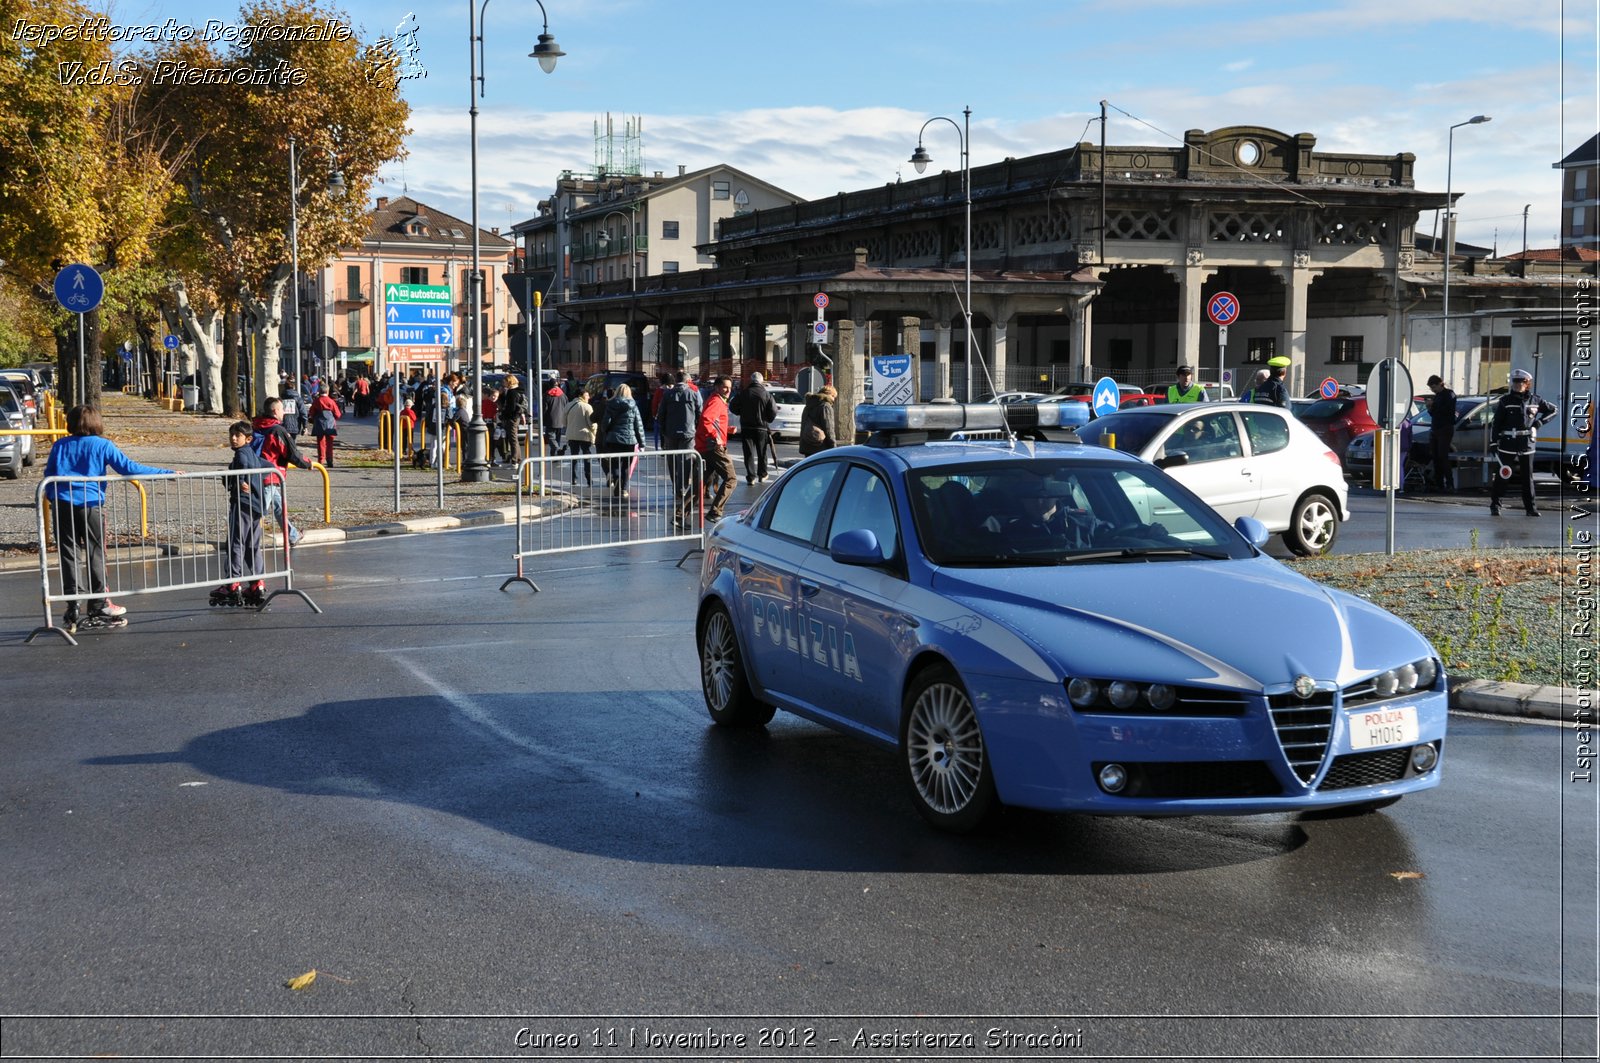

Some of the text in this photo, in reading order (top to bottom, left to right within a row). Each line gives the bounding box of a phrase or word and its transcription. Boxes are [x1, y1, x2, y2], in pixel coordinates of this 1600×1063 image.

[410, 289, 449, 299] autostrada
[422, 309, 450, 319] TORINO
[882, 365, 890, 376] 5
[878, 382, 895, 398] Buona
[751, 593, 864, 683] POLIZIA
[1365, 711, 1403, 726] POLIZIA
[1369, 725, 1403, 745] H1015
